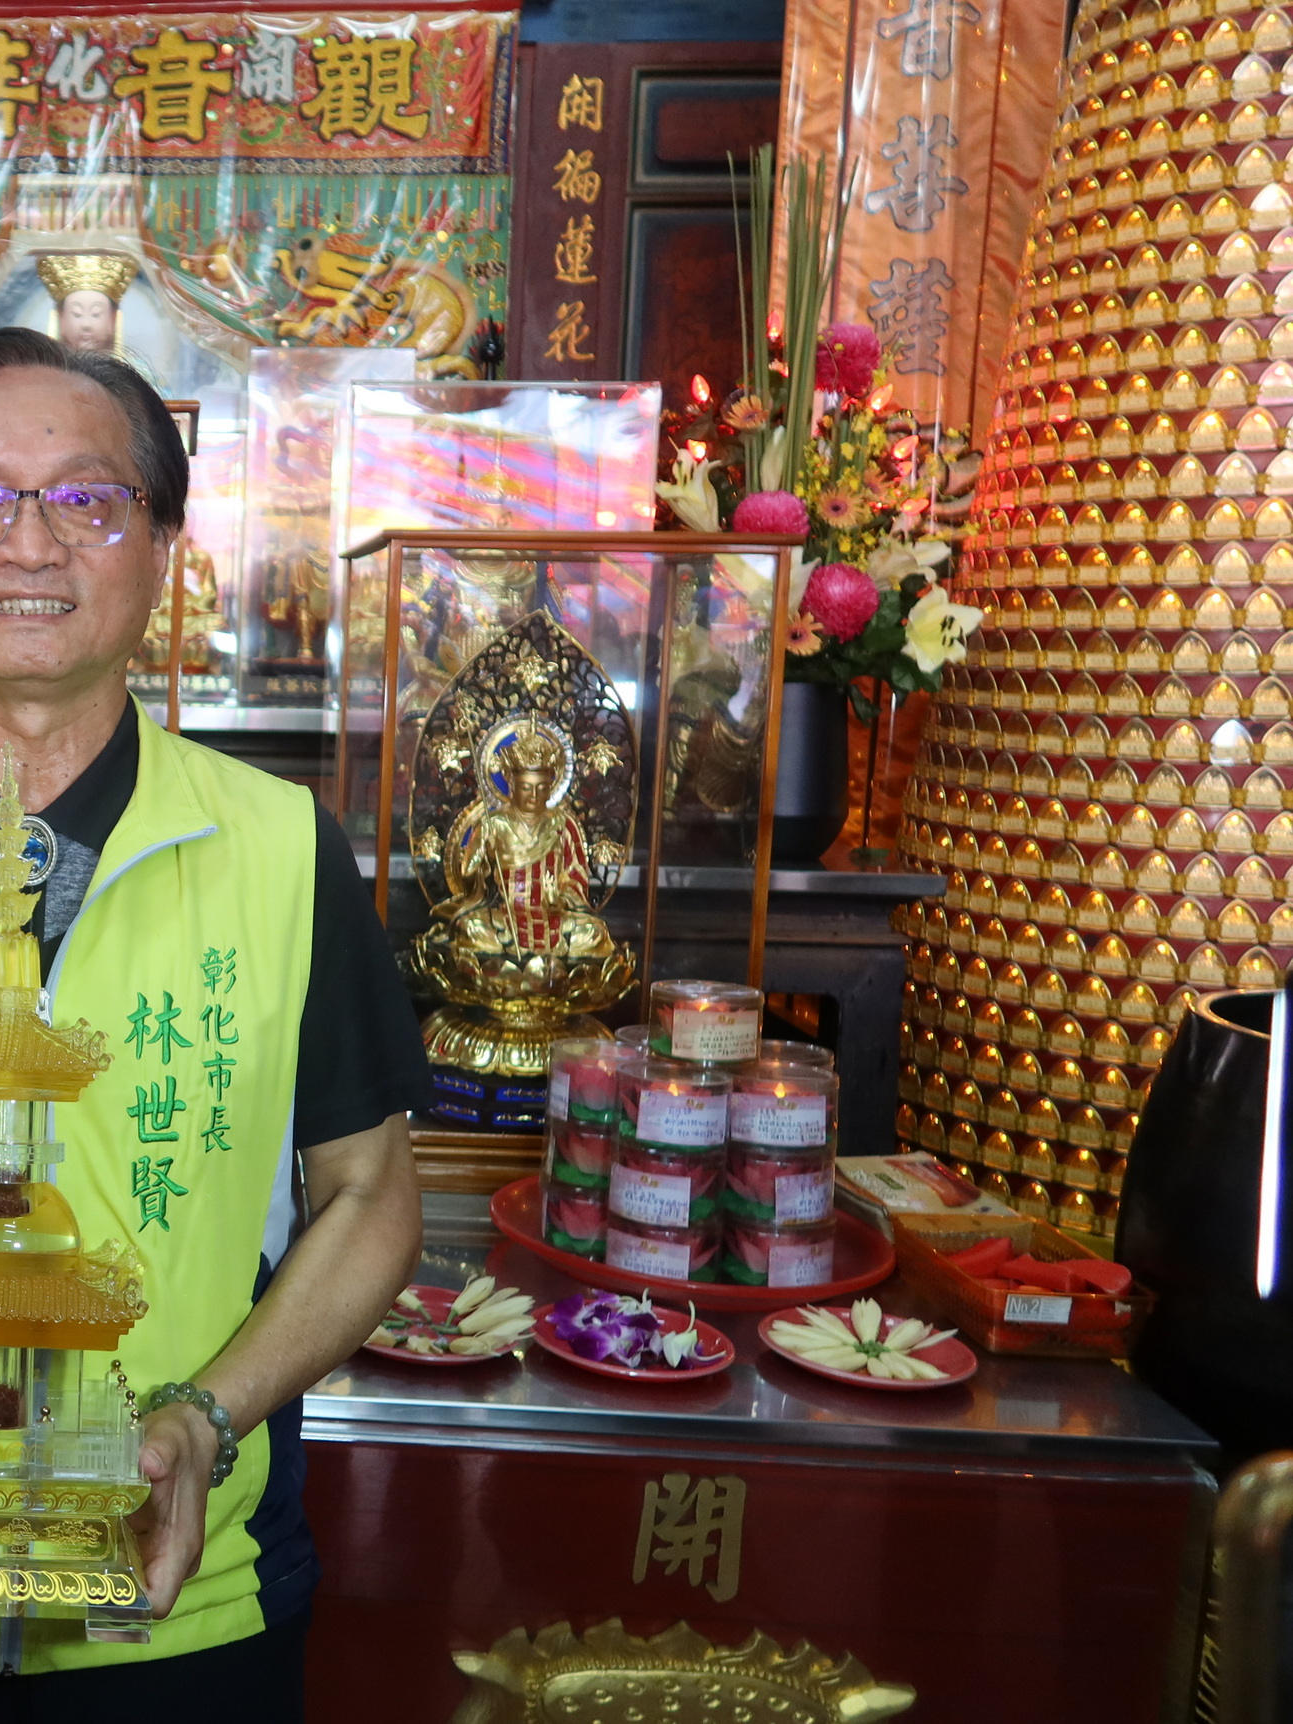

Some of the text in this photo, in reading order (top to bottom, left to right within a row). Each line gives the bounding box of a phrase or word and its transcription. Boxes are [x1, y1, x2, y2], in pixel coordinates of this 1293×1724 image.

[123, 990, 194, 1233] 林世賢
[199, 946, 239, 1153] 彰化市長
